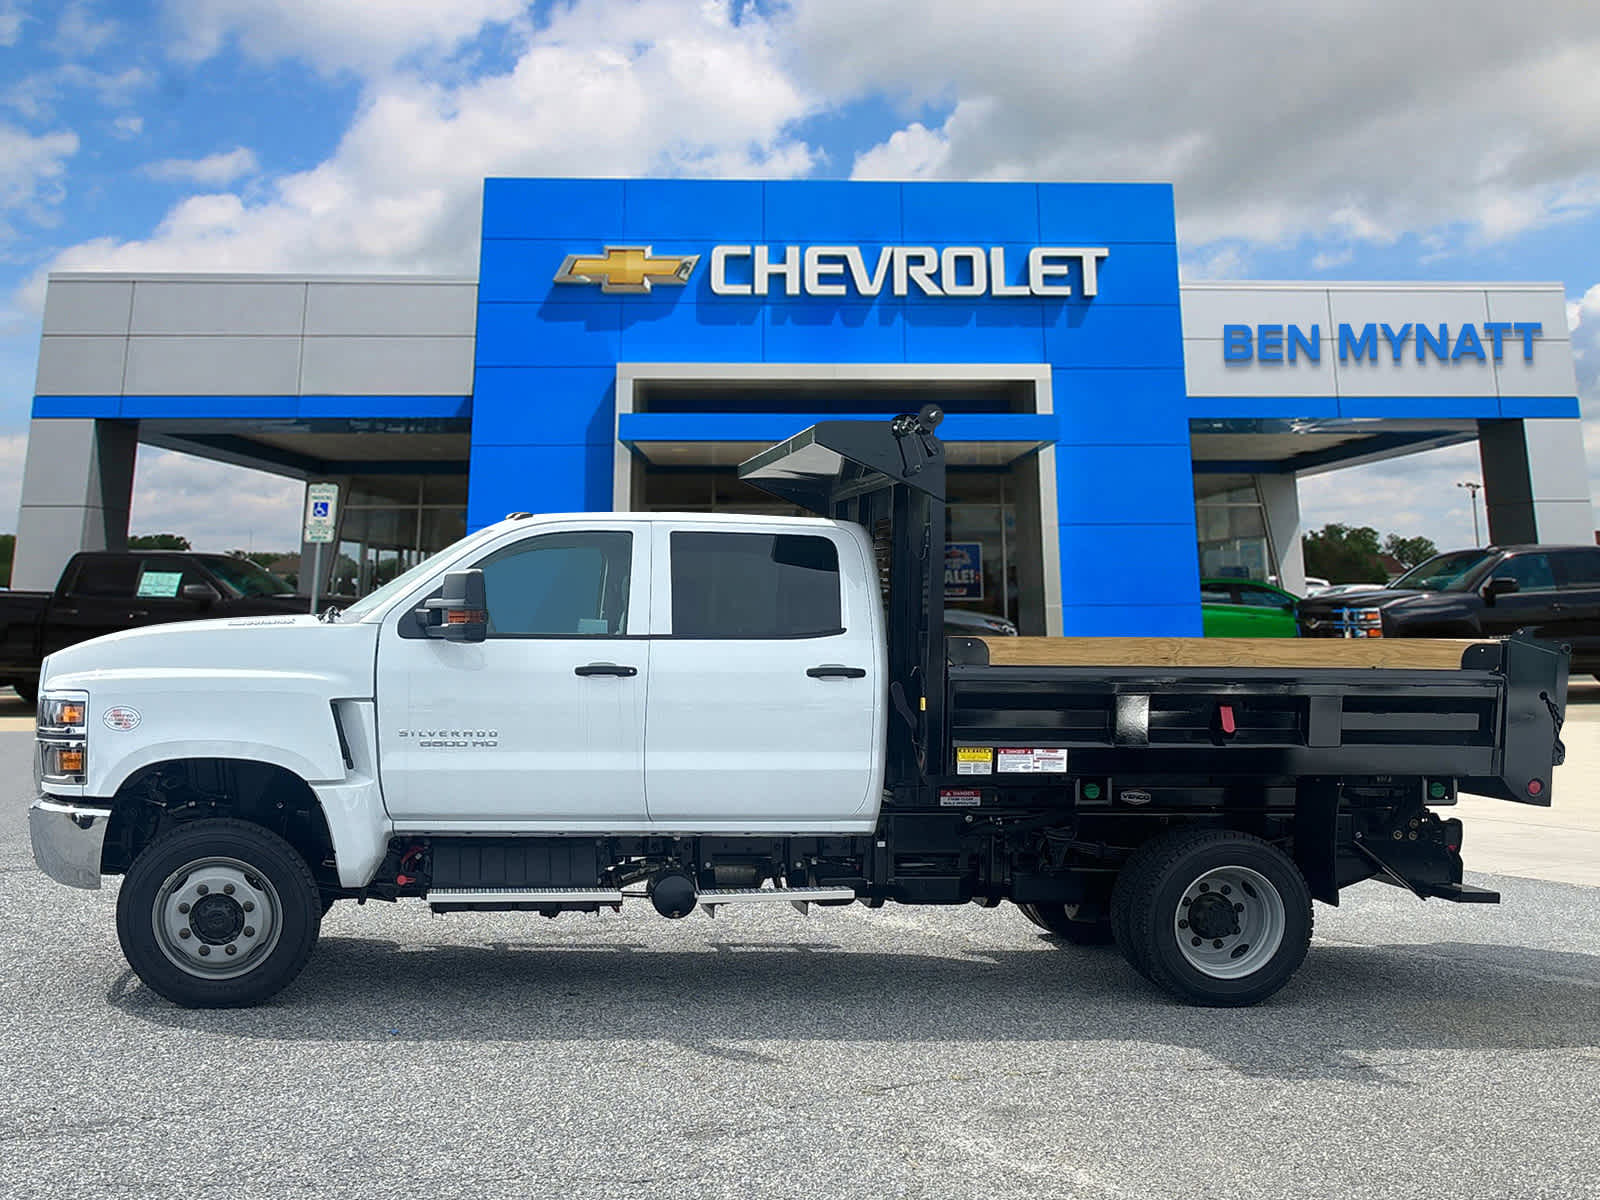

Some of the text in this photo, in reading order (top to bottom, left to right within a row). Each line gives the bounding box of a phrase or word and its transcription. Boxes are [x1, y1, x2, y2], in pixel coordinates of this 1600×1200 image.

[710, 245, 1109, 297] CHEVROLET
[1223, 321, 1543, 364] BEN MYNATT
[944, 569, 975, 585] ALE!
[398, 729, 499, 738] SILVERADO
